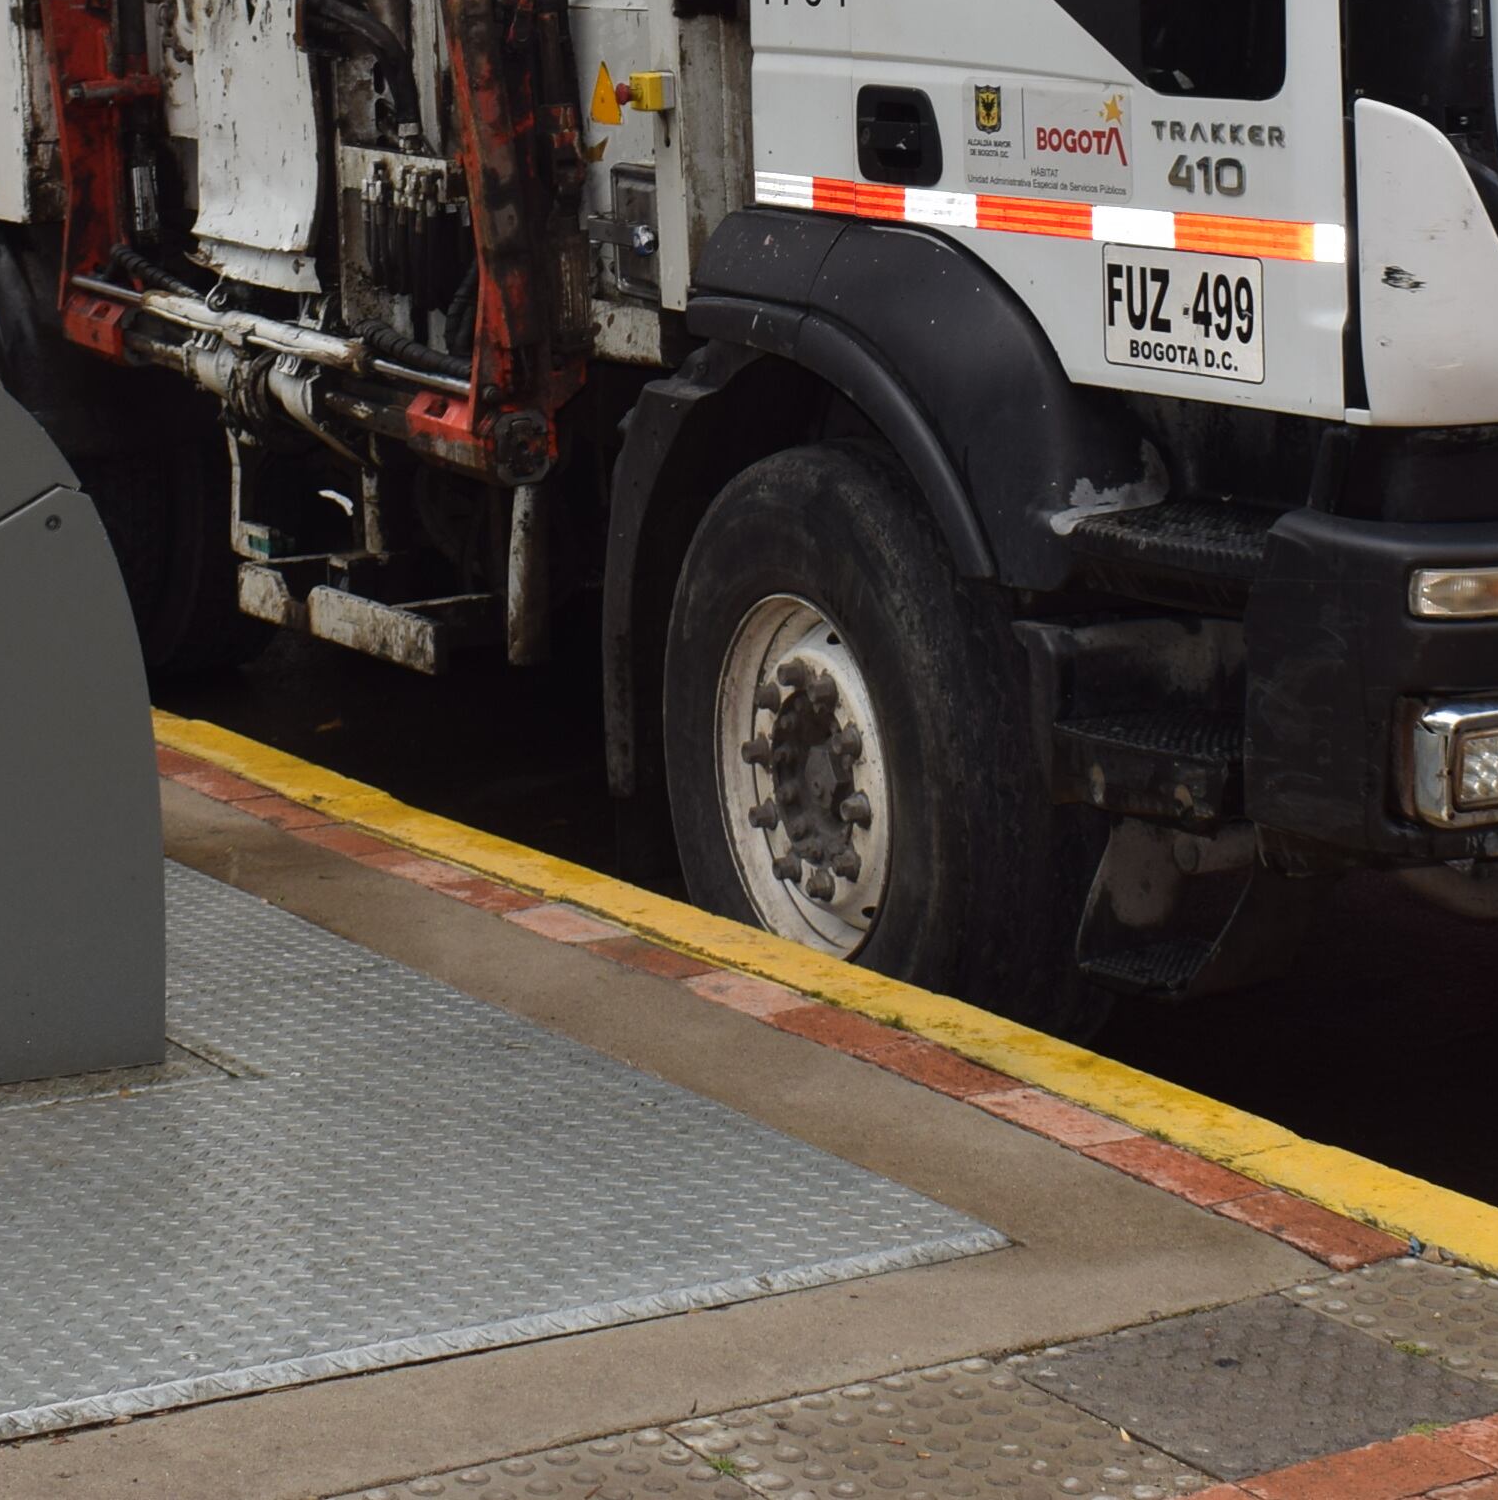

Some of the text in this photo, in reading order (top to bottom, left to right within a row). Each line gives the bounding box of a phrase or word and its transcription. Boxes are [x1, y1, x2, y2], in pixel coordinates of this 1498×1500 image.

[1151, 119, 1286, 148] TRAKKER
[967, 174, 1127, 196] Unidad Administrativa Especial de Servicios Públicos
[1030, 167, 1059, 178] HÁBITAT
[1168, 154, 1246, 197] 410
[1107, 263, 1253, 344] FUZ 499
[1130, 339, 1239, 372] BOGOTA D.C.
